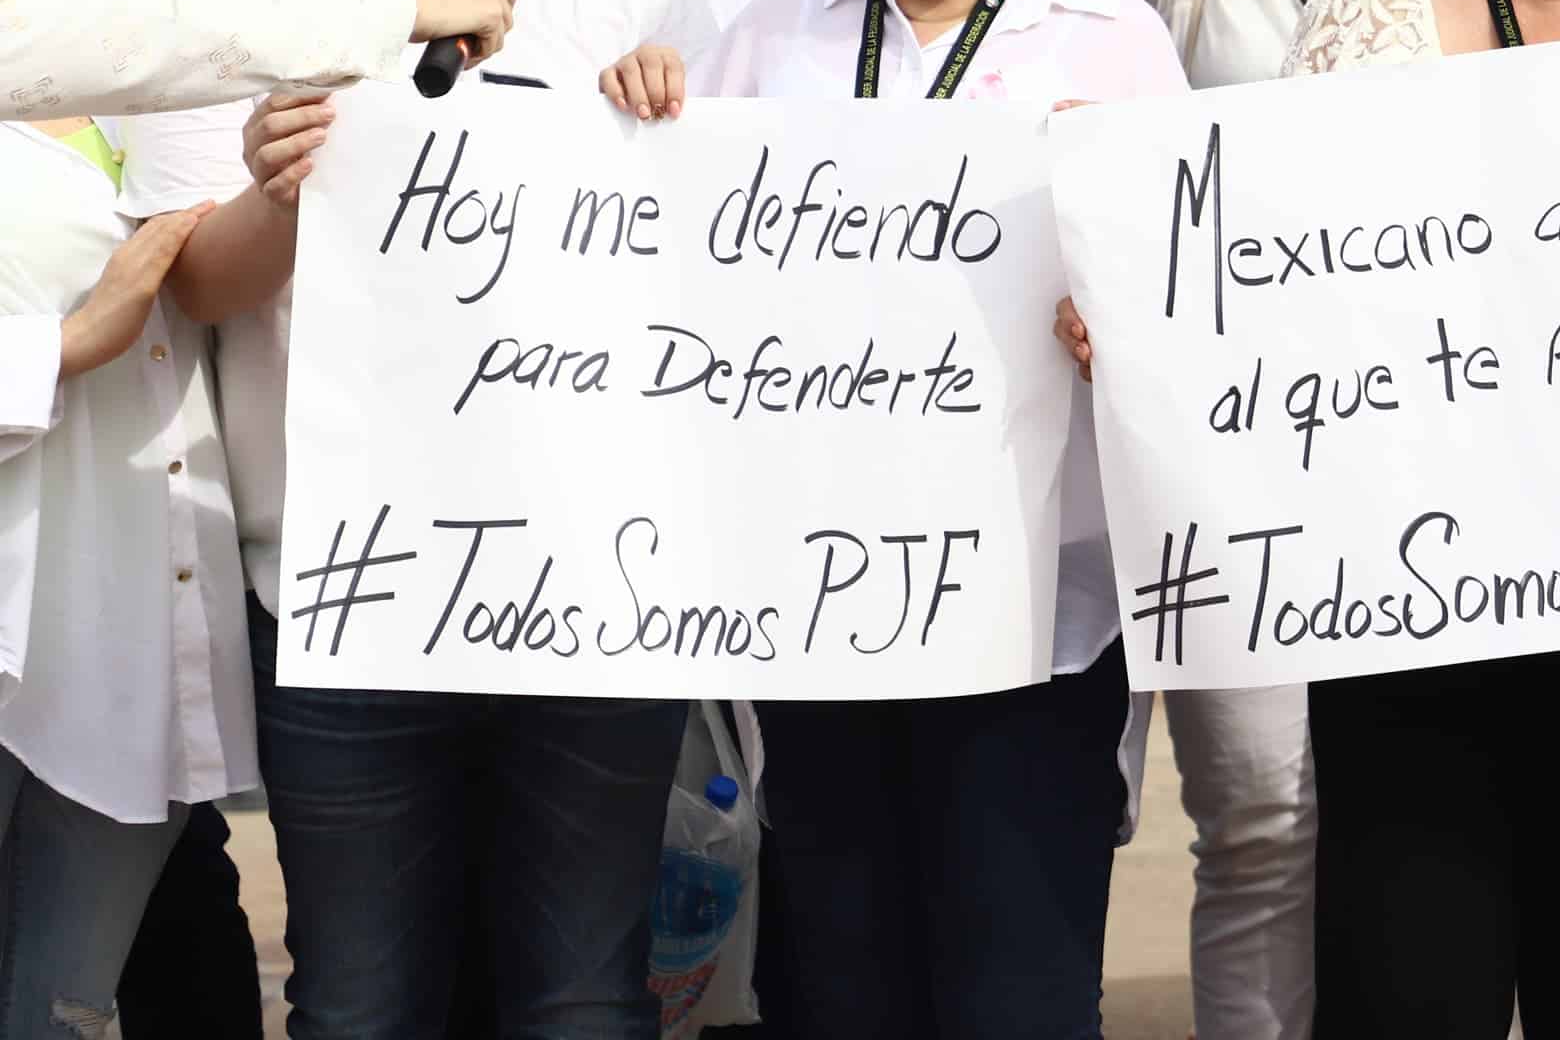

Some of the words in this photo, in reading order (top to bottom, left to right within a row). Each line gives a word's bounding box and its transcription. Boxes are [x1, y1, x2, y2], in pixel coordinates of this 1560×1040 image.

[379, 129, 526, 304] Hoy
[561, 188, 659, 256] me
[708, 144, 1001, 272] defiendo
[1165, 122, 1492, 336] Mexicano
[453, 338, 609, 416] para
[640, 325, 981, 420] Defenderte
[1209, 357, 1262, 433] al
[1285, 365, 1399, 472] que
[1426, 318, 1500, 402] te
